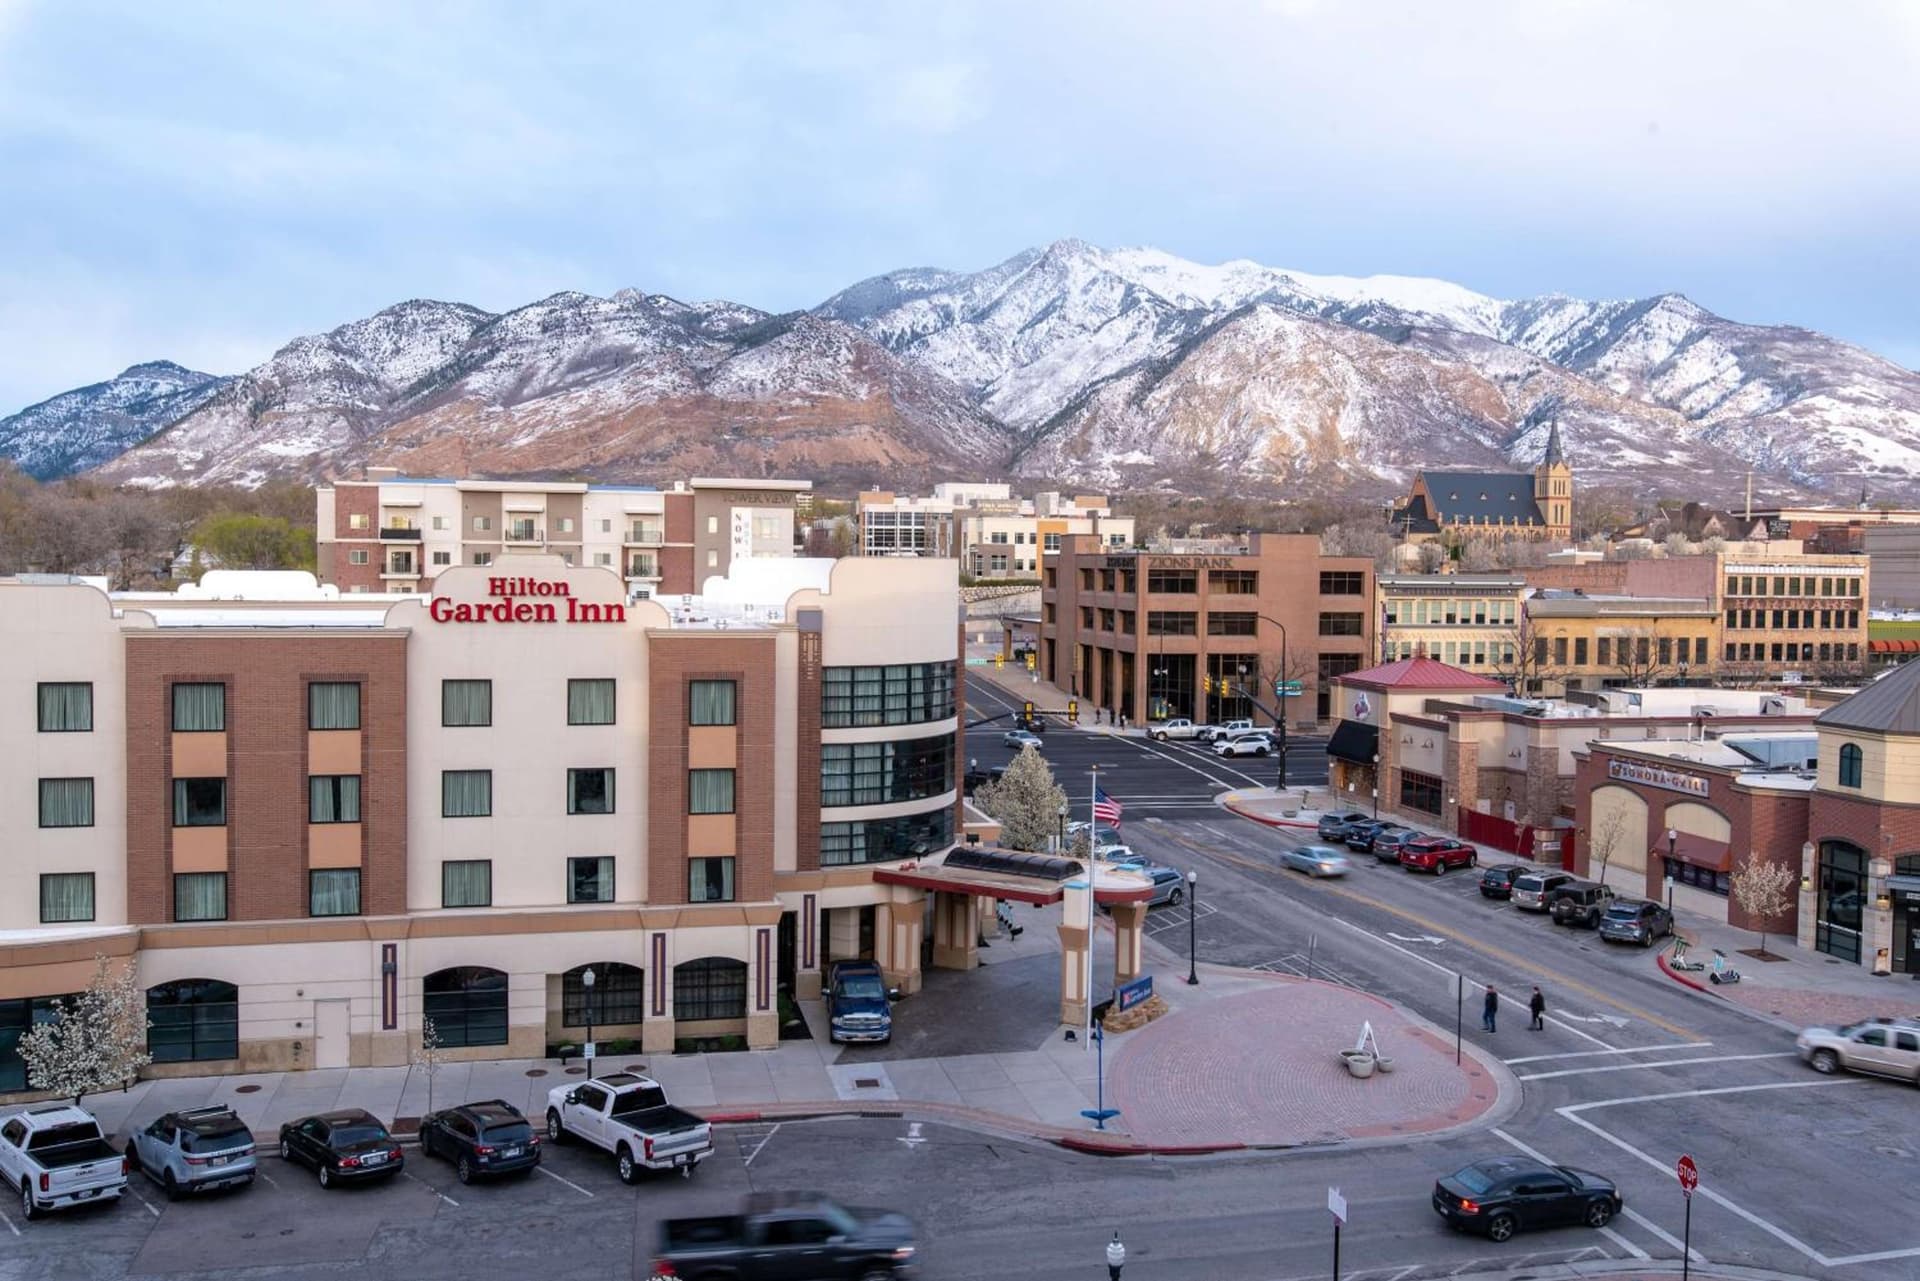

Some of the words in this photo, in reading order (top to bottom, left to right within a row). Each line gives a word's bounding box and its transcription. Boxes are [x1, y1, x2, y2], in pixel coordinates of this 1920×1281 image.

[764, 493, 793, 504] VIEW
[1148, 556, 1191, 569] ZIONS
[1193, 556, 1234, 569] BANK
[488, 577, 570, 597] Hilton
[430, 597, 558, 623] Garden
[565, 598, 626, 623] Inn
[1735, 599, 1851, 610] HARDWARE
[1679, 1163, 1697, 1183] STOP
